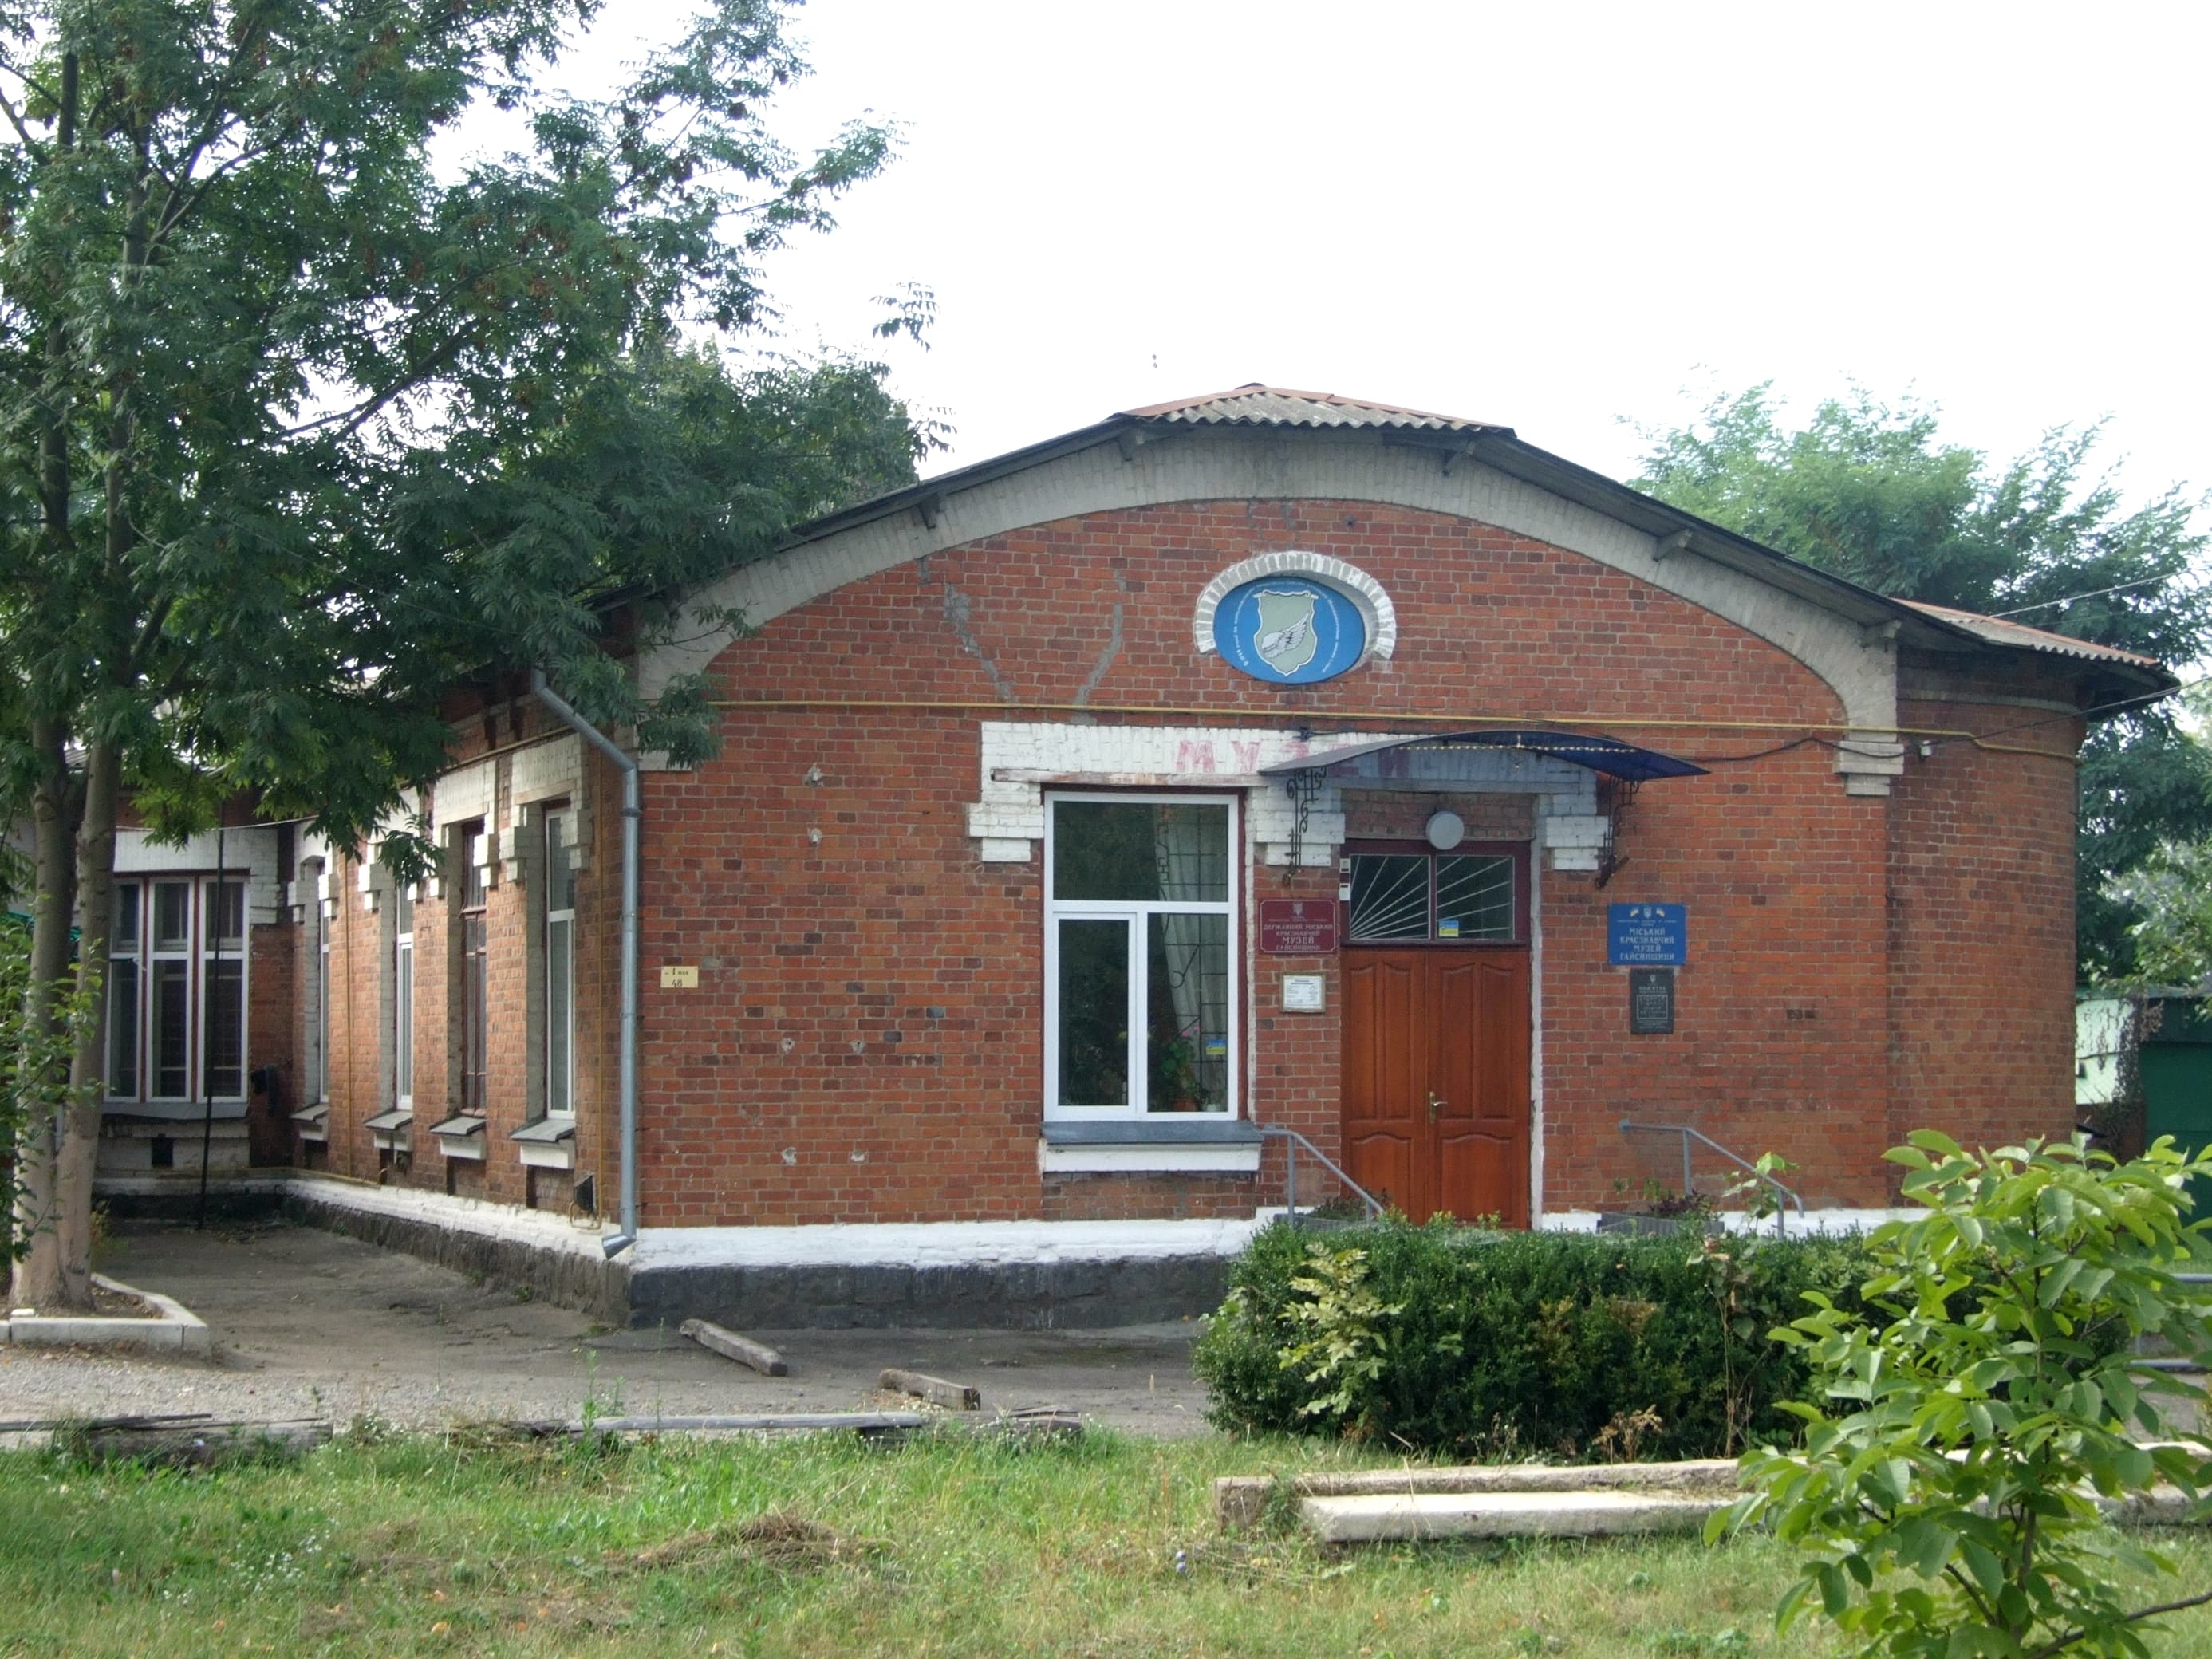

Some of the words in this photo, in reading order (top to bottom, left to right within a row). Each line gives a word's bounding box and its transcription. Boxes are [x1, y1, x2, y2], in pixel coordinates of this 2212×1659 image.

[1629, 927, 1666, 936] МІСЬКИЙ
[1282, 936, 1315, 944] МУЗЕЙ
[1633, 944, 1662, 952] МУЗЕЙ
